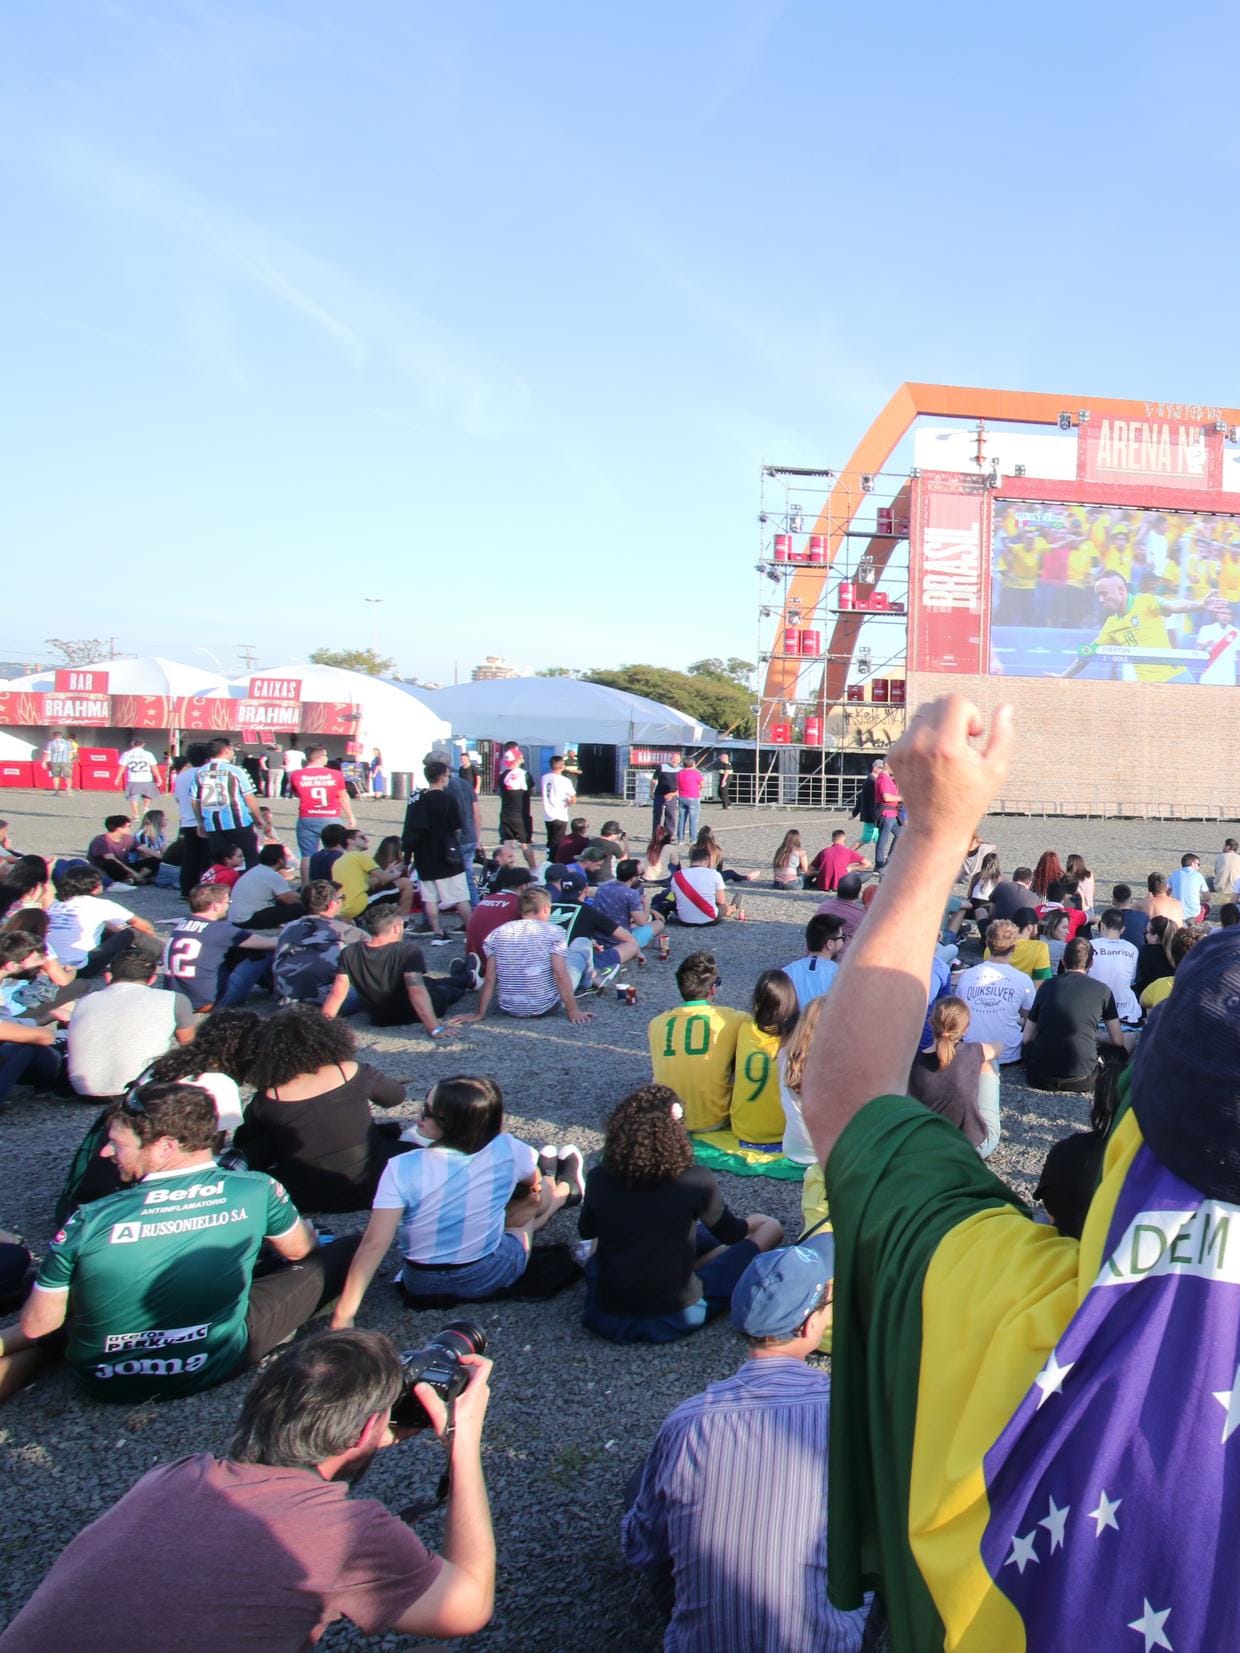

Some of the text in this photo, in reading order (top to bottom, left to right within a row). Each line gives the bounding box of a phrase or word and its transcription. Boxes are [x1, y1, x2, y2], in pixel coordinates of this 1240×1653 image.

[1097, 419, 1172, 472] ARENA
[922, 522, 979, 608] BRASIL
[69, 673, 93, 691] BAR
[254, 680, 297, 698] CAIXAS
[45, 700, 109, 718] BRAHMA
[238, 704, 300, 723] BRAHMA
[128, 760, 148, 773] 22
[202, 783, 228, 807] 23
[311, 786, 328, 807] 9
[163, 936, 203, 978] 12
[967, 984, 1016, 1003] QUIKSILVER
[663, 1013, 711, 1057] 10
[744, 1051, 770, 1102] 9
[144, 1180, 225, 1205] Befol
[141, 1197, 228, 1216] ANTIINFLAMATORIO
[141, 1211, 230, 1238] RUSSONIELLO
